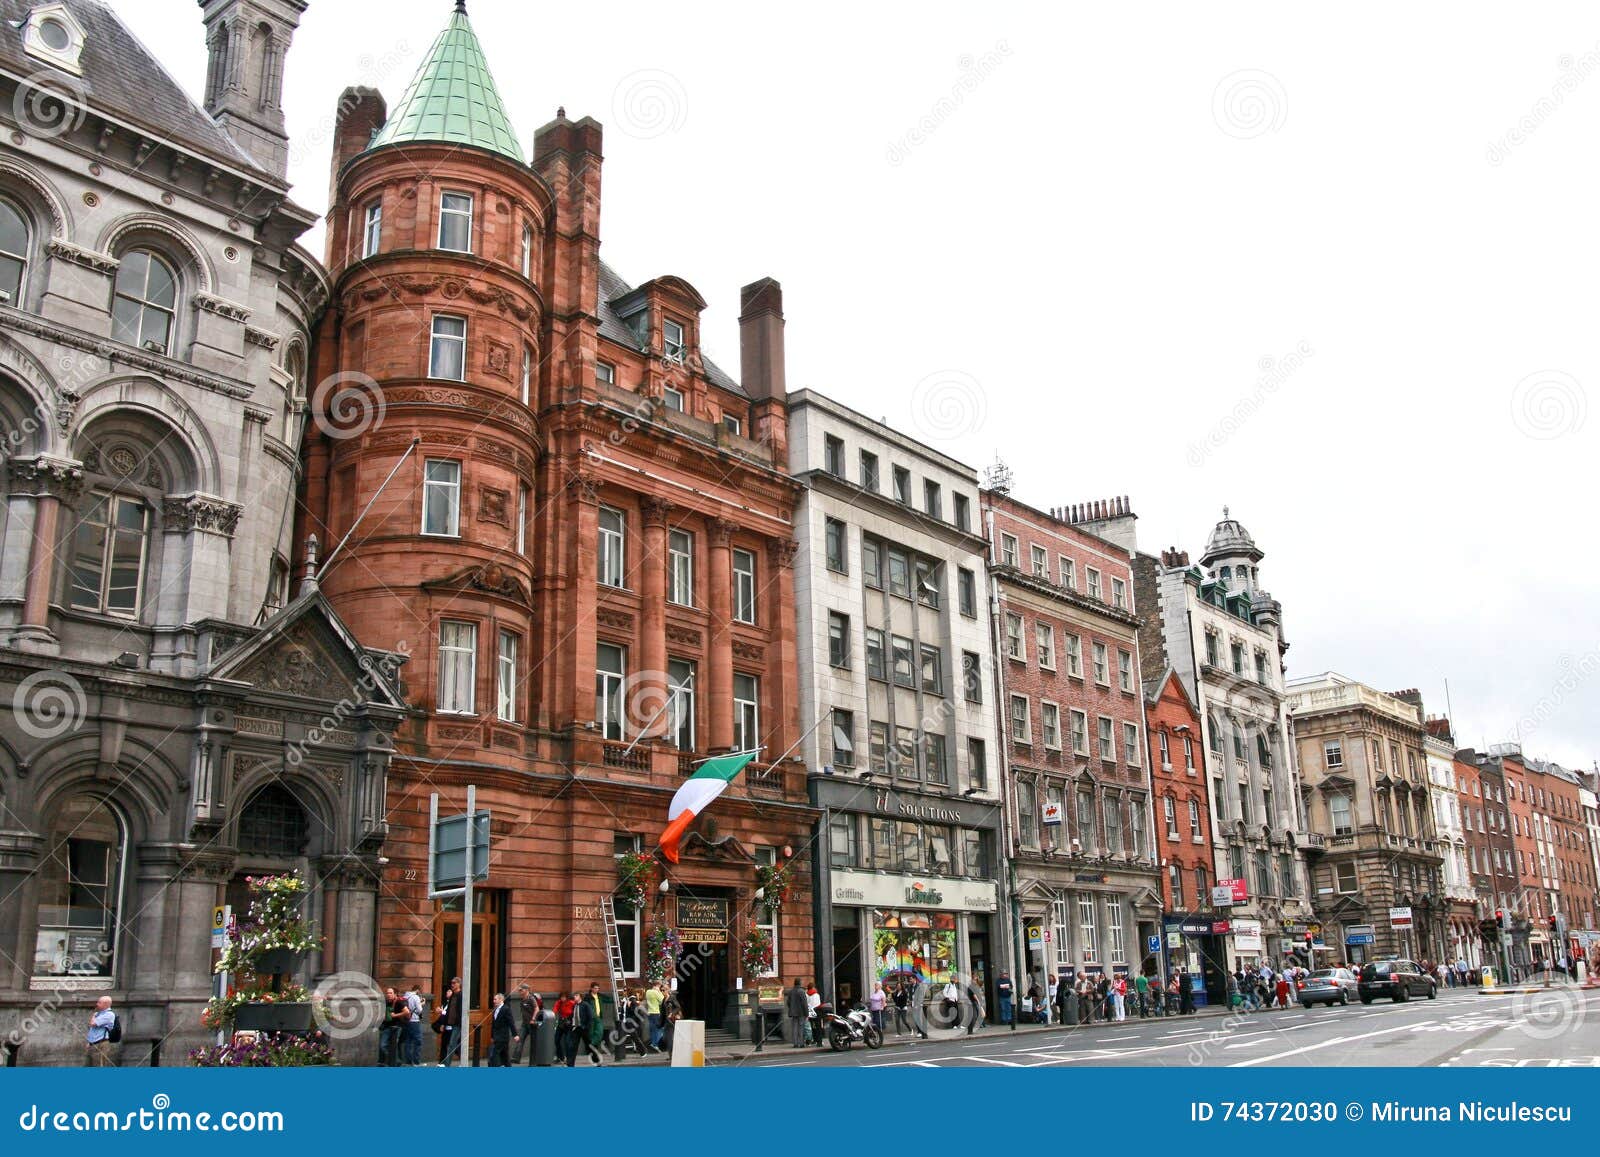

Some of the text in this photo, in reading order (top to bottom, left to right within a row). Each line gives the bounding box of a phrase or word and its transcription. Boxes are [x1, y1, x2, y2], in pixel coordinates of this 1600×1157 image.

[899, 804, 961, 822] SOLUTIONS
[404, 869, 416, 880] 22
[835, 887, 864, 901] Griffins
